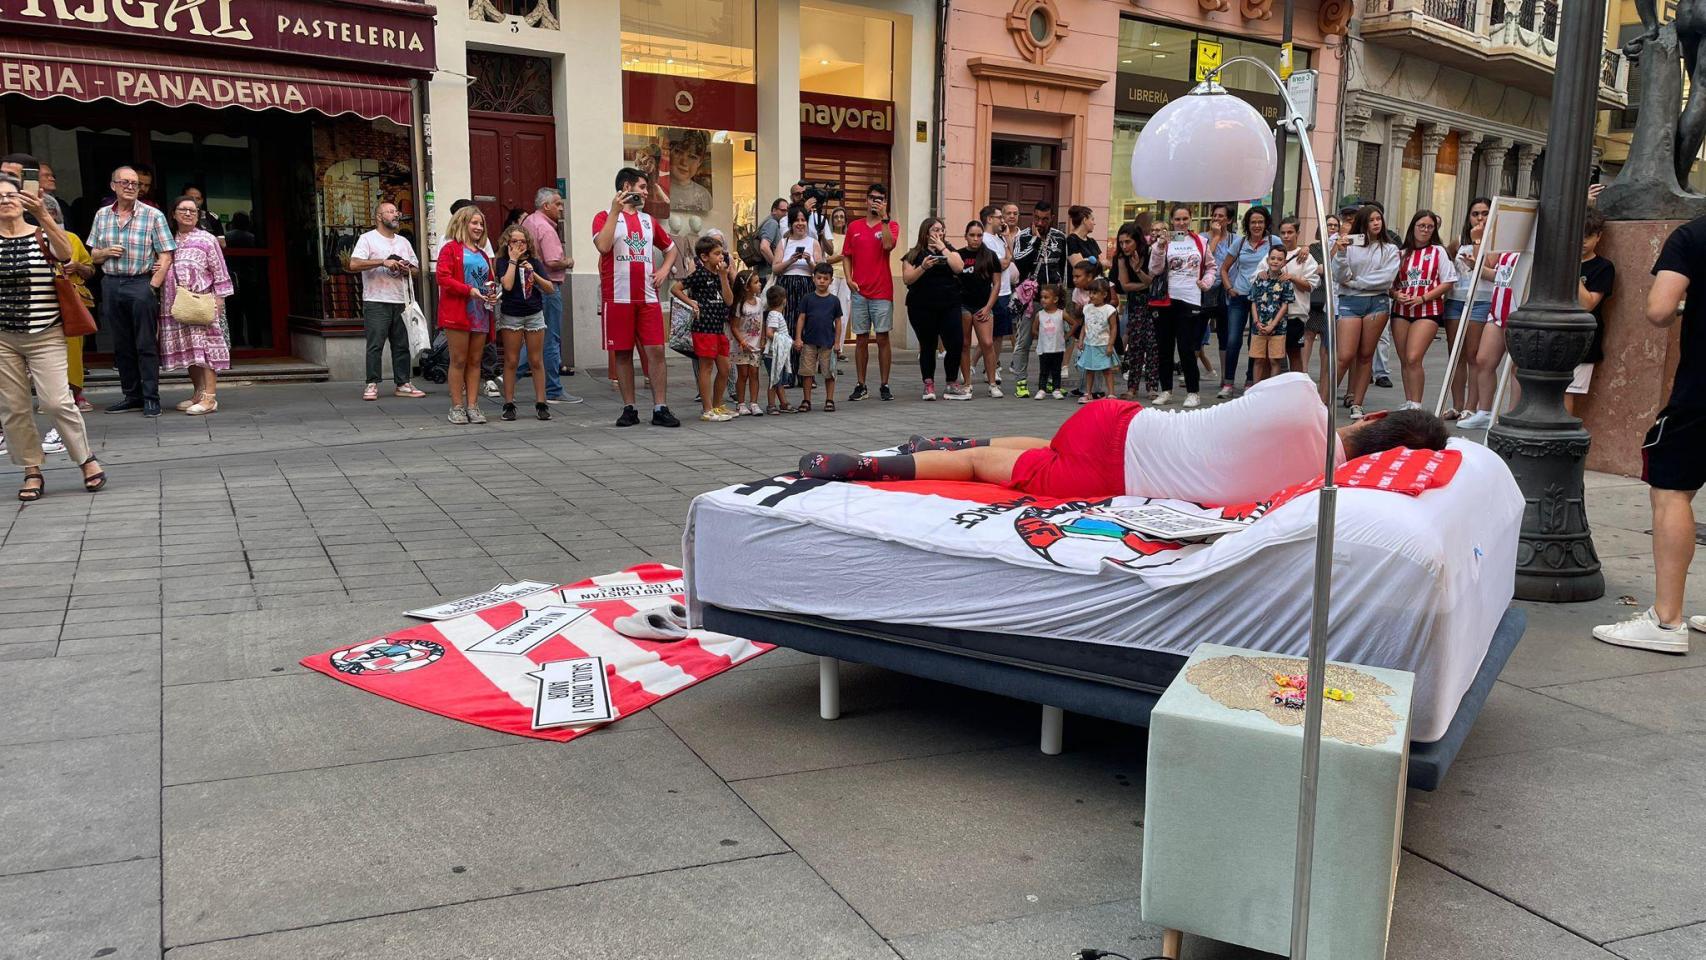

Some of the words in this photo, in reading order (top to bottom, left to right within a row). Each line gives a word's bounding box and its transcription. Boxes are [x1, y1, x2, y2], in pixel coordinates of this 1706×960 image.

[277, 14, 425, 53] PASTELERIA
[511, 20, 519, 34] 3
[0, 63, 84, 94] ERIA
[116, 71, 306, 106] PANADERIA
[1033, 90, 1041, 104] 4
[1129, 88, 1169, 104] LIBRERÍA
[547, 681, 569, 700] AMOR
